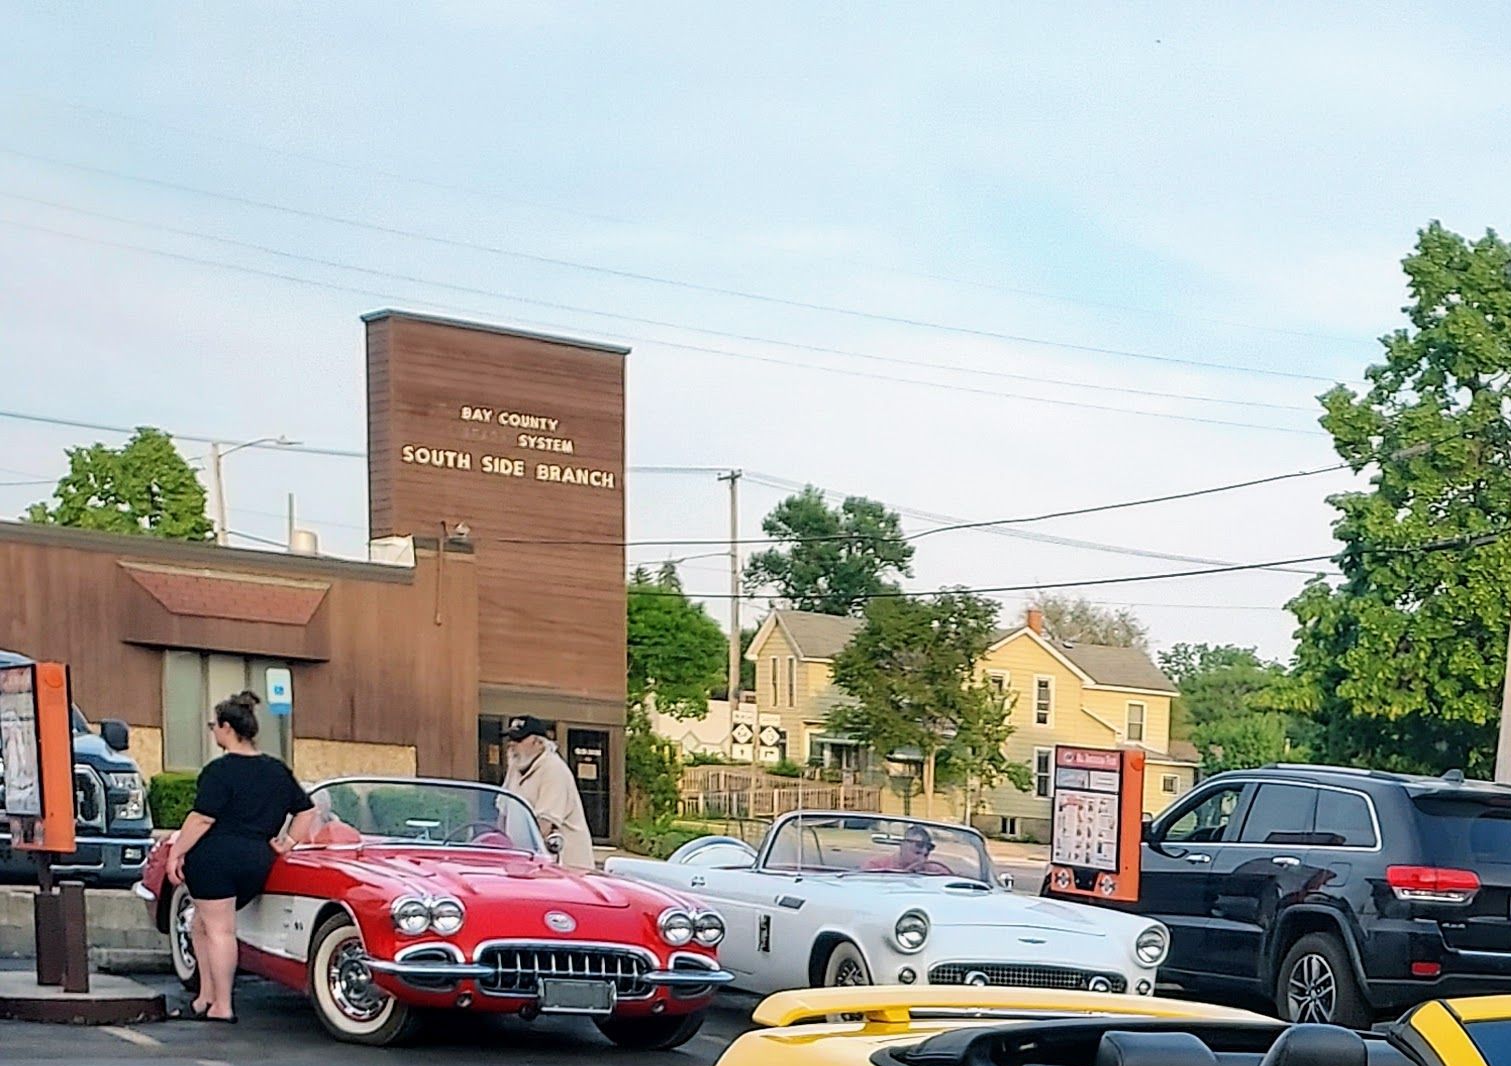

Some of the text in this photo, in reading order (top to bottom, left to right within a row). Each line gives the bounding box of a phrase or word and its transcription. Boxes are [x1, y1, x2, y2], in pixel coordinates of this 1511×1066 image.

[461, 406, 559, 431] BAY COUNTY
[518, 434, 575, 454] SYSTEM
[402, 445, 615, 488] SOUTH SIDE BRANCH
